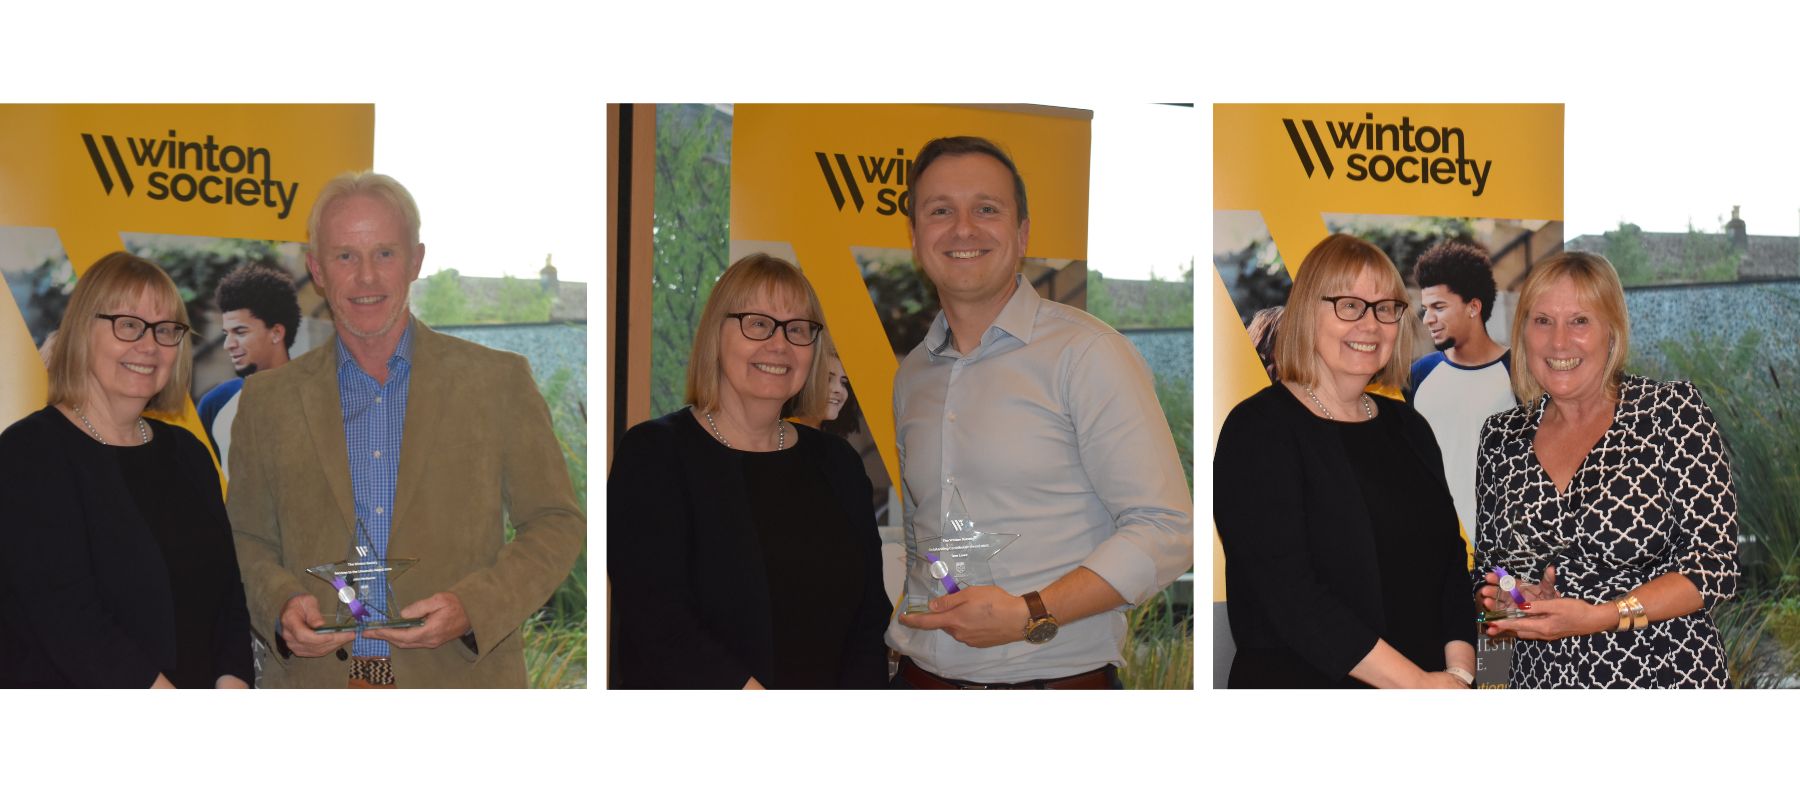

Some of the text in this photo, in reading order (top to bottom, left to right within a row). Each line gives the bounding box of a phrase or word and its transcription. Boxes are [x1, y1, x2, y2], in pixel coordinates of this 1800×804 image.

[126, 130, 271, 176] winton
[1326, 112, 1465, 156] winton
[147, 171, 299, 219] society
[1346, 153, 1492, 197] society
